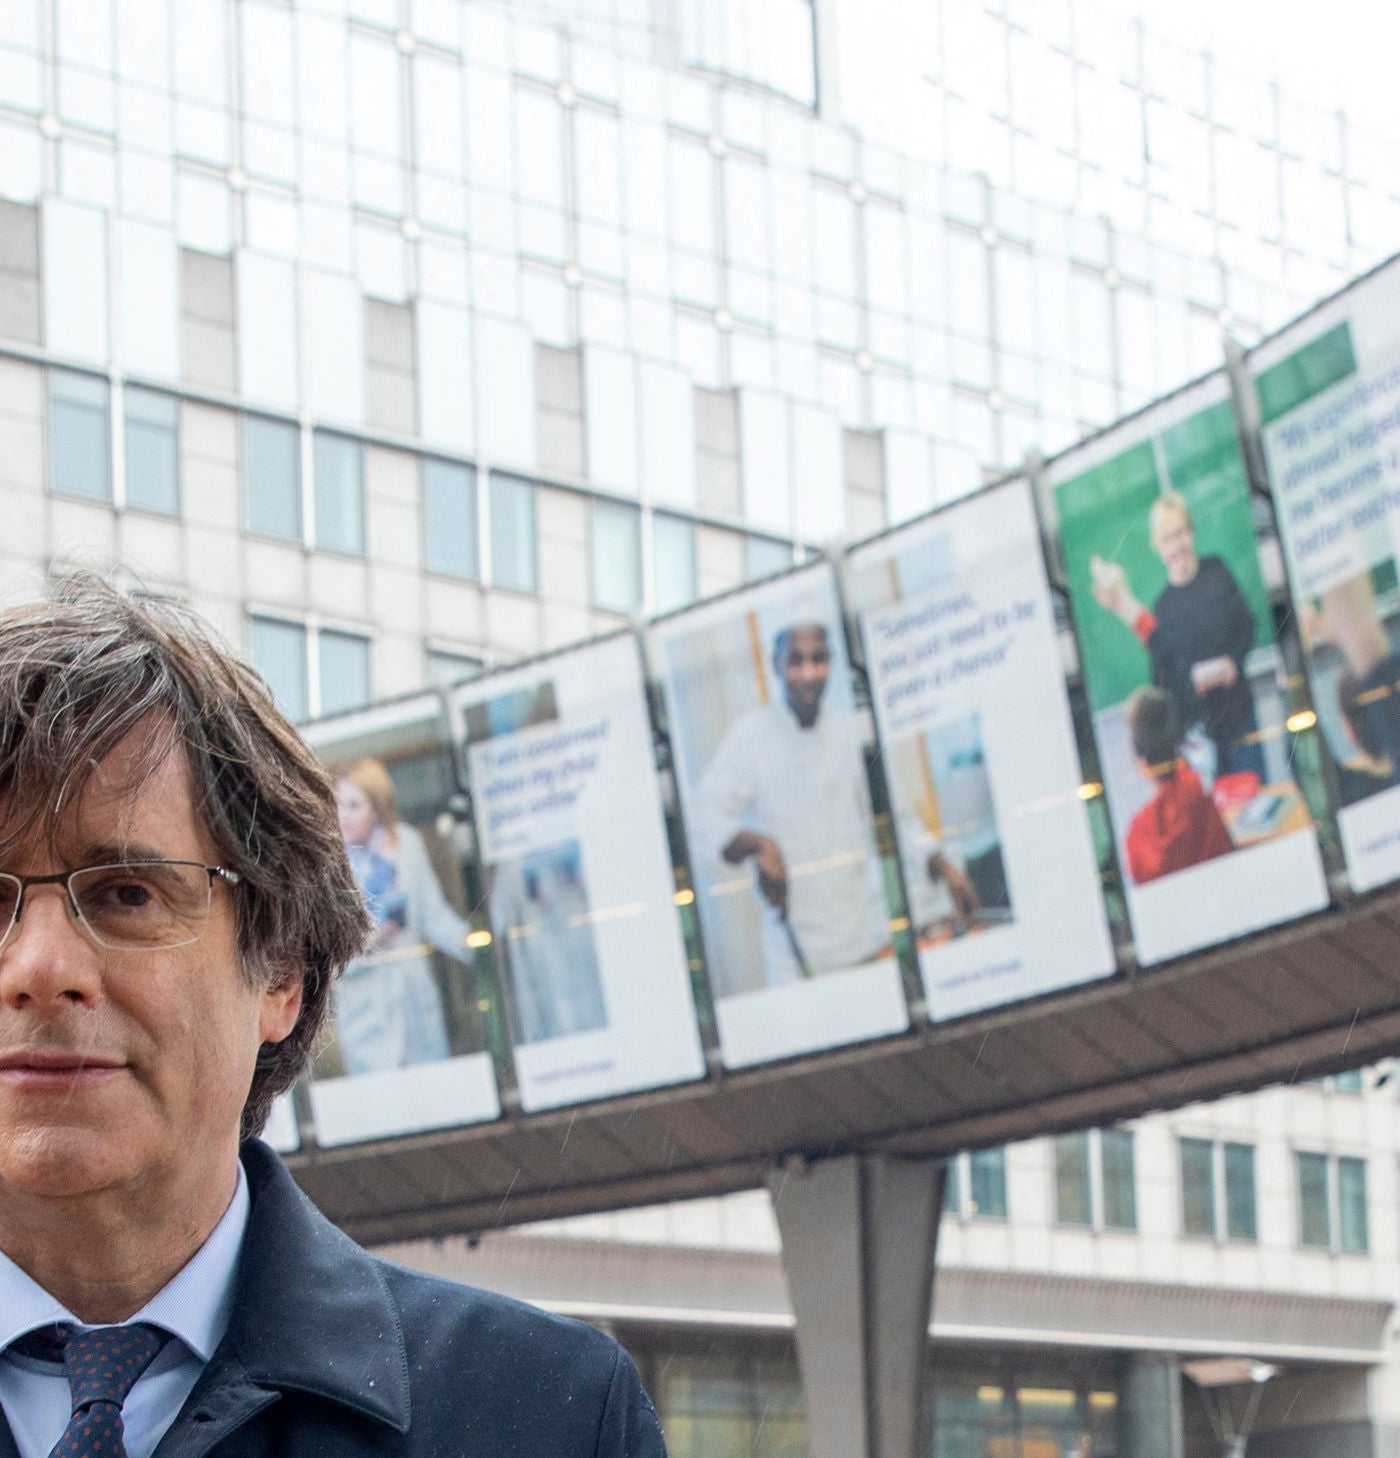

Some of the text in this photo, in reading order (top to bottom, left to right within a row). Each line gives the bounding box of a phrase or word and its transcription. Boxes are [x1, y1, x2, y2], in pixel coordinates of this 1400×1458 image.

[1291, 500, 1314, 521] me
[1319, 461, 1383, 501] become
[1296, 520, 1345, 557] better
[880, 653, 906, 678] you
[914, 634, 941, 663] just
[950, 615, 985, 644] need
[1014, 600, 1035, 619] be
[885, 676, 927, 708] given
